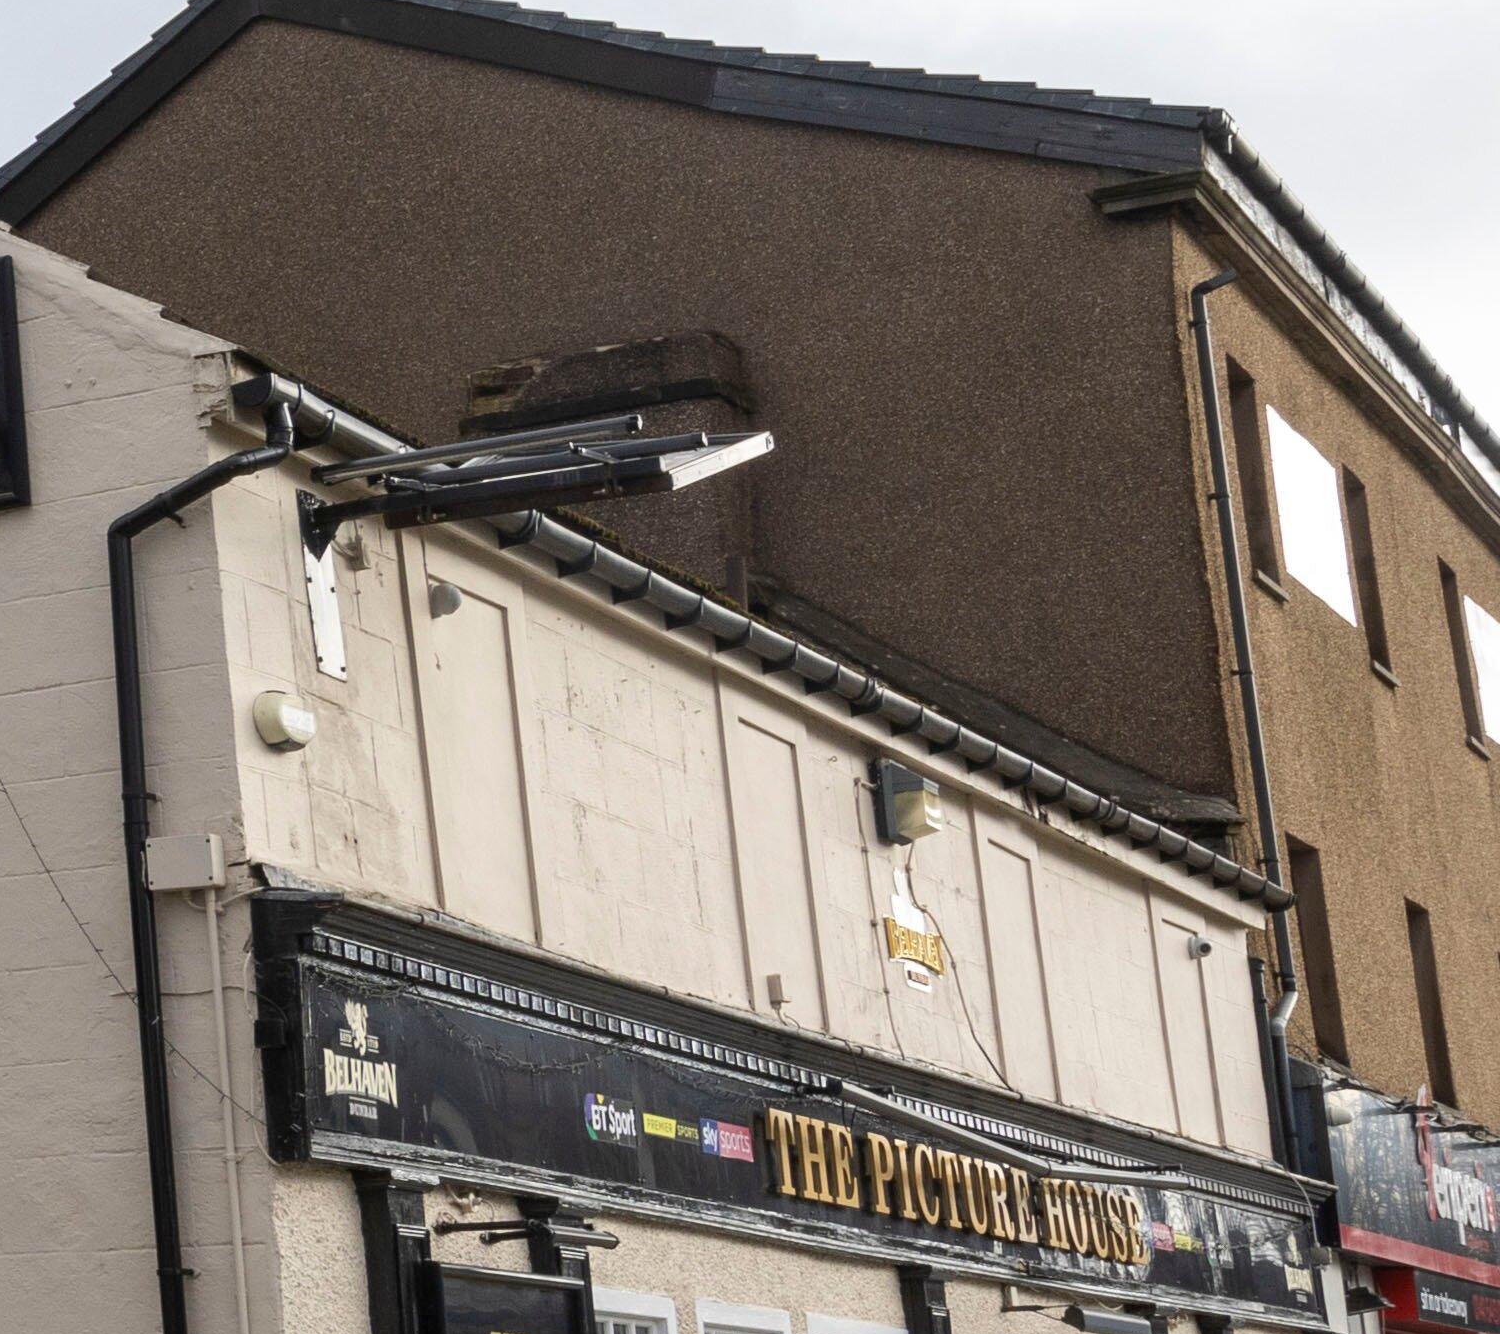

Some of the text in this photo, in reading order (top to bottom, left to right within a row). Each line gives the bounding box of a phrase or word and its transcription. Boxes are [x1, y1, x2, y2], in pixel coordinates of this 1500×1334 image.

[323, 1047, 398, 1108] BELHAVEN
[591, 1103, 637, 1140] BT Sport
[646, 1116, 700, 1140] PREMIER SPORTS
[703, 1121, 750, 1154] sky sports
[766, 1107, 1151, 1265] THE PICTURE HOUSE
